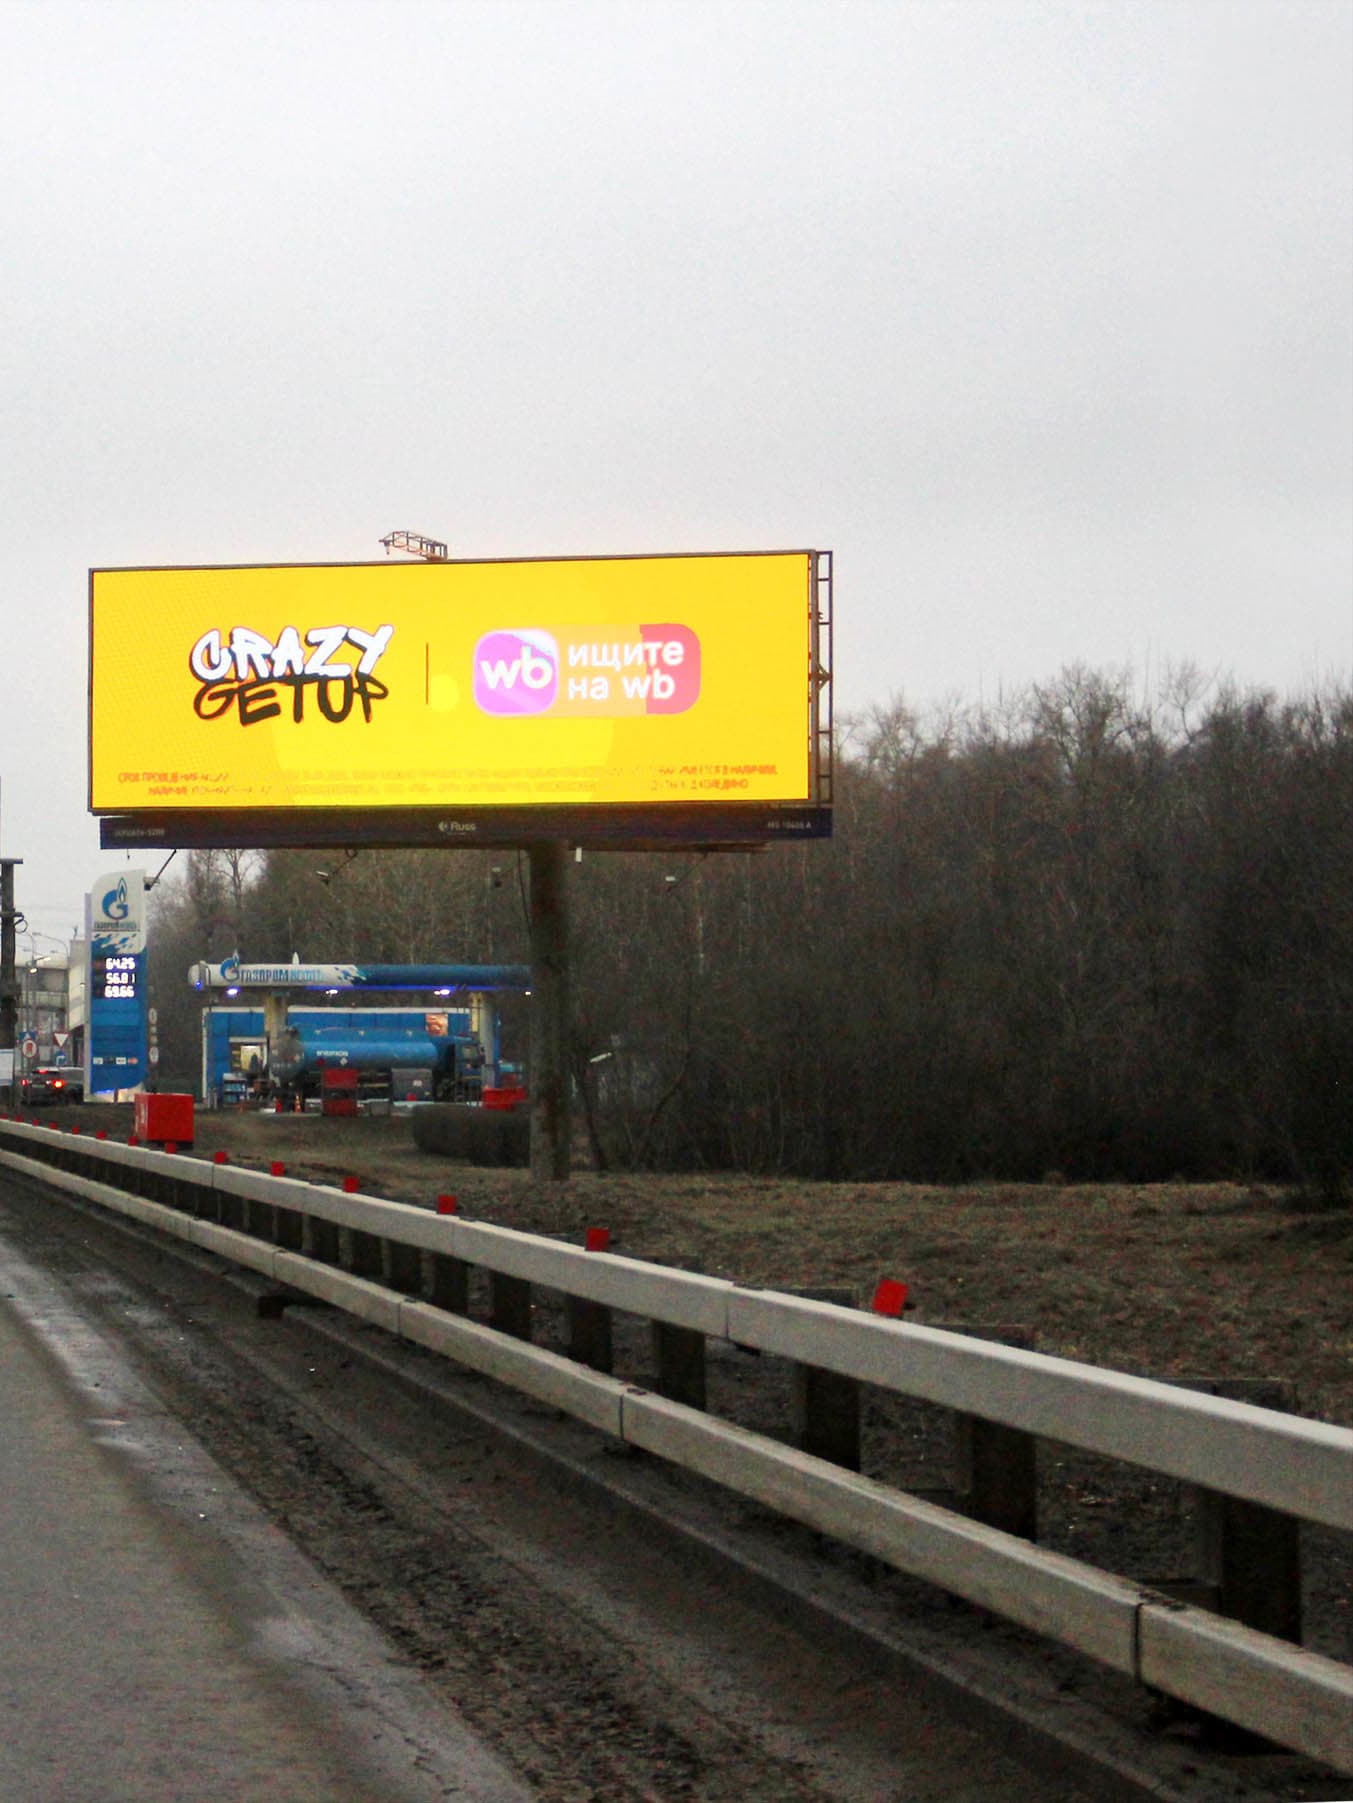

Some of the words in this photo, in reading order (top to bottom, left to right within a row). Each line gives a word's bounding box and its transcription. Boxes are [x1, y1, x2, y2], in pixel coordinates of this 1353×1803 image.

[189, 624, 395, 683] CRAZY
[479, 645, 553, 689] wb
[568, 639, 685, 671] ищите
[193, 672, 389, 727] GETUP
[568, 675, 609, 700] на
[621, 667, 676, 699] wb
